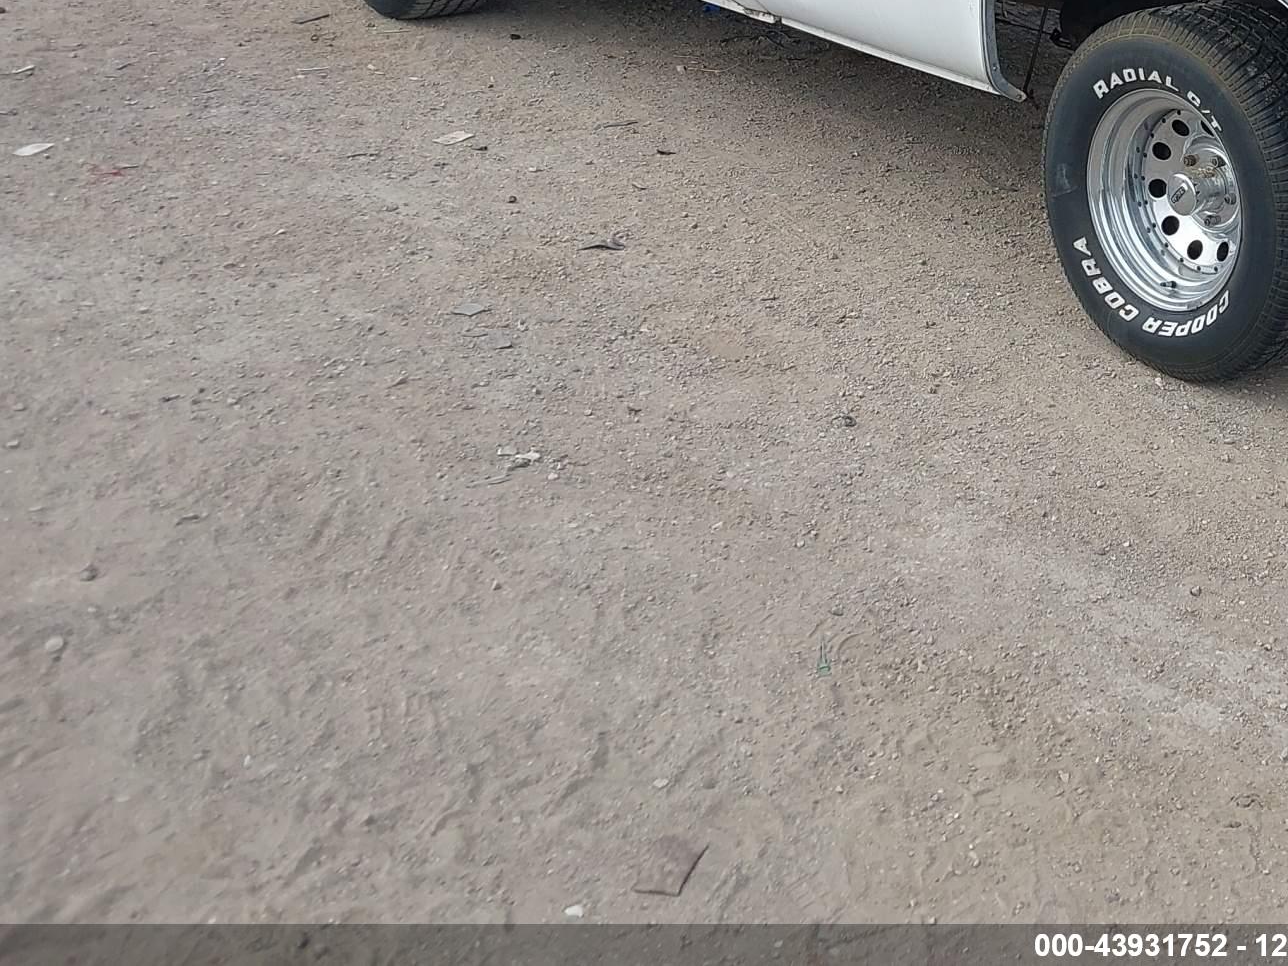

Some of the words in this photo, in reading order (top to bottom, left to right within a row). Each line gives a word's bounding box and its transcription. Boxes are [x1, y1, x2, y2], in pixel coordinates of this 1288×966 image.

[1092, 67, 1180, 100] RADIAL
[1073, 236, 1140, 322] COBRA
[1142, 289, 1230, 338] COOPER
